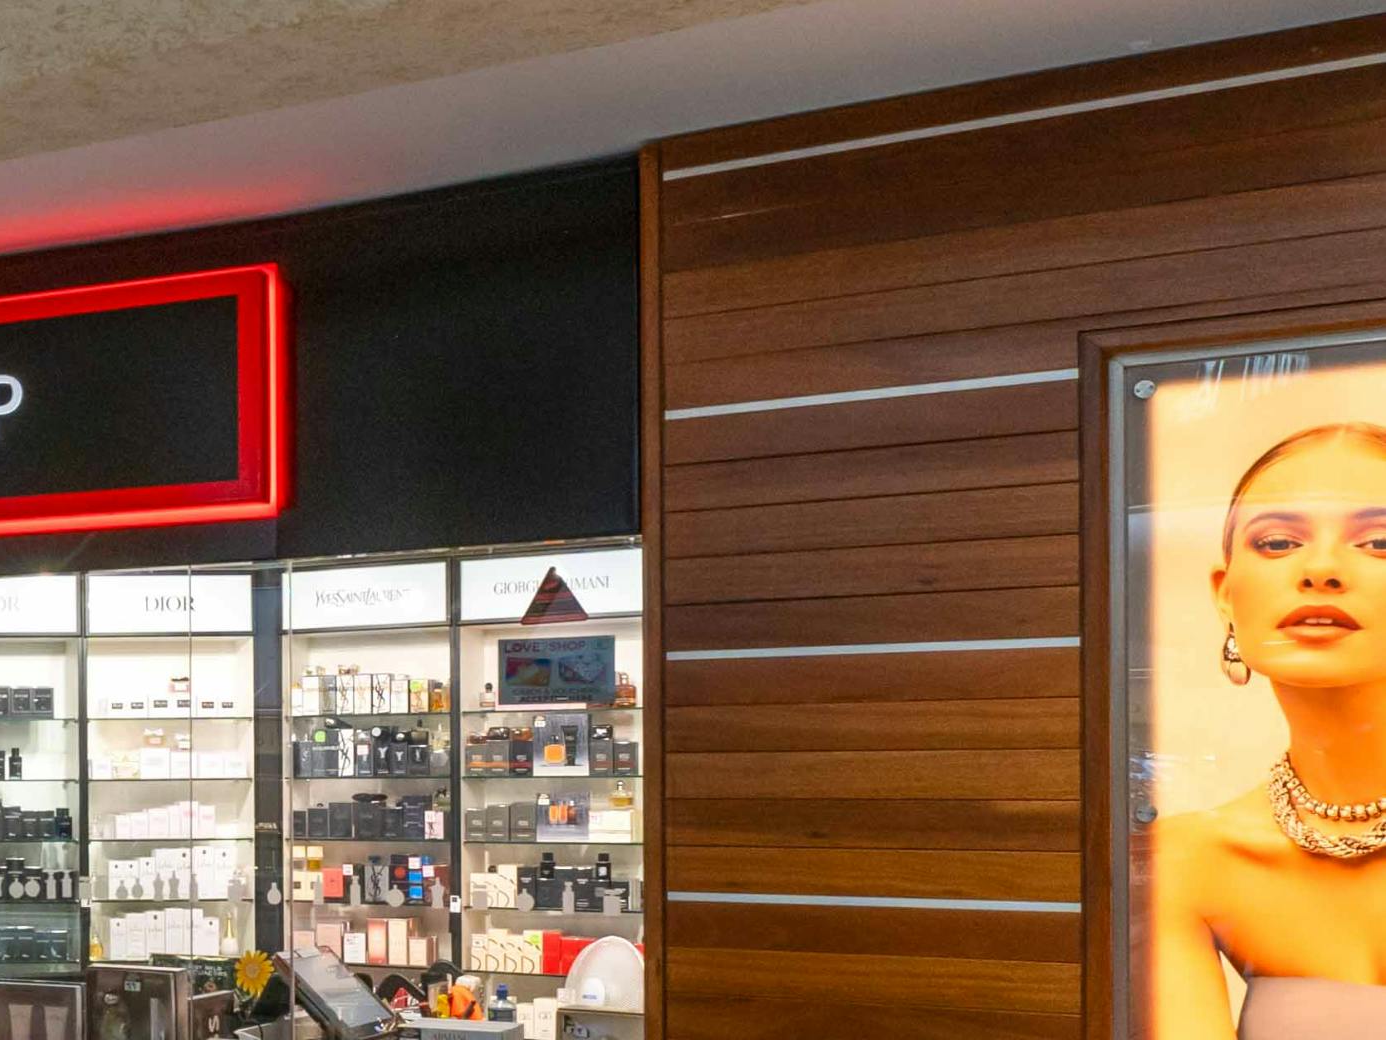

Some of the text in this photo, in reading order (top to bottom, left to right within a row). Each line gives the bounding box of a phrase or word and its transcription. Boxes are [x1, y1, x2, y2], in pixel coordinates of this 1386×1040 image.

[493, 579, 541, 595] GIORGI
[144, 595, 196, 613] DIOR
[548, 640, 586, 652] SHOP
